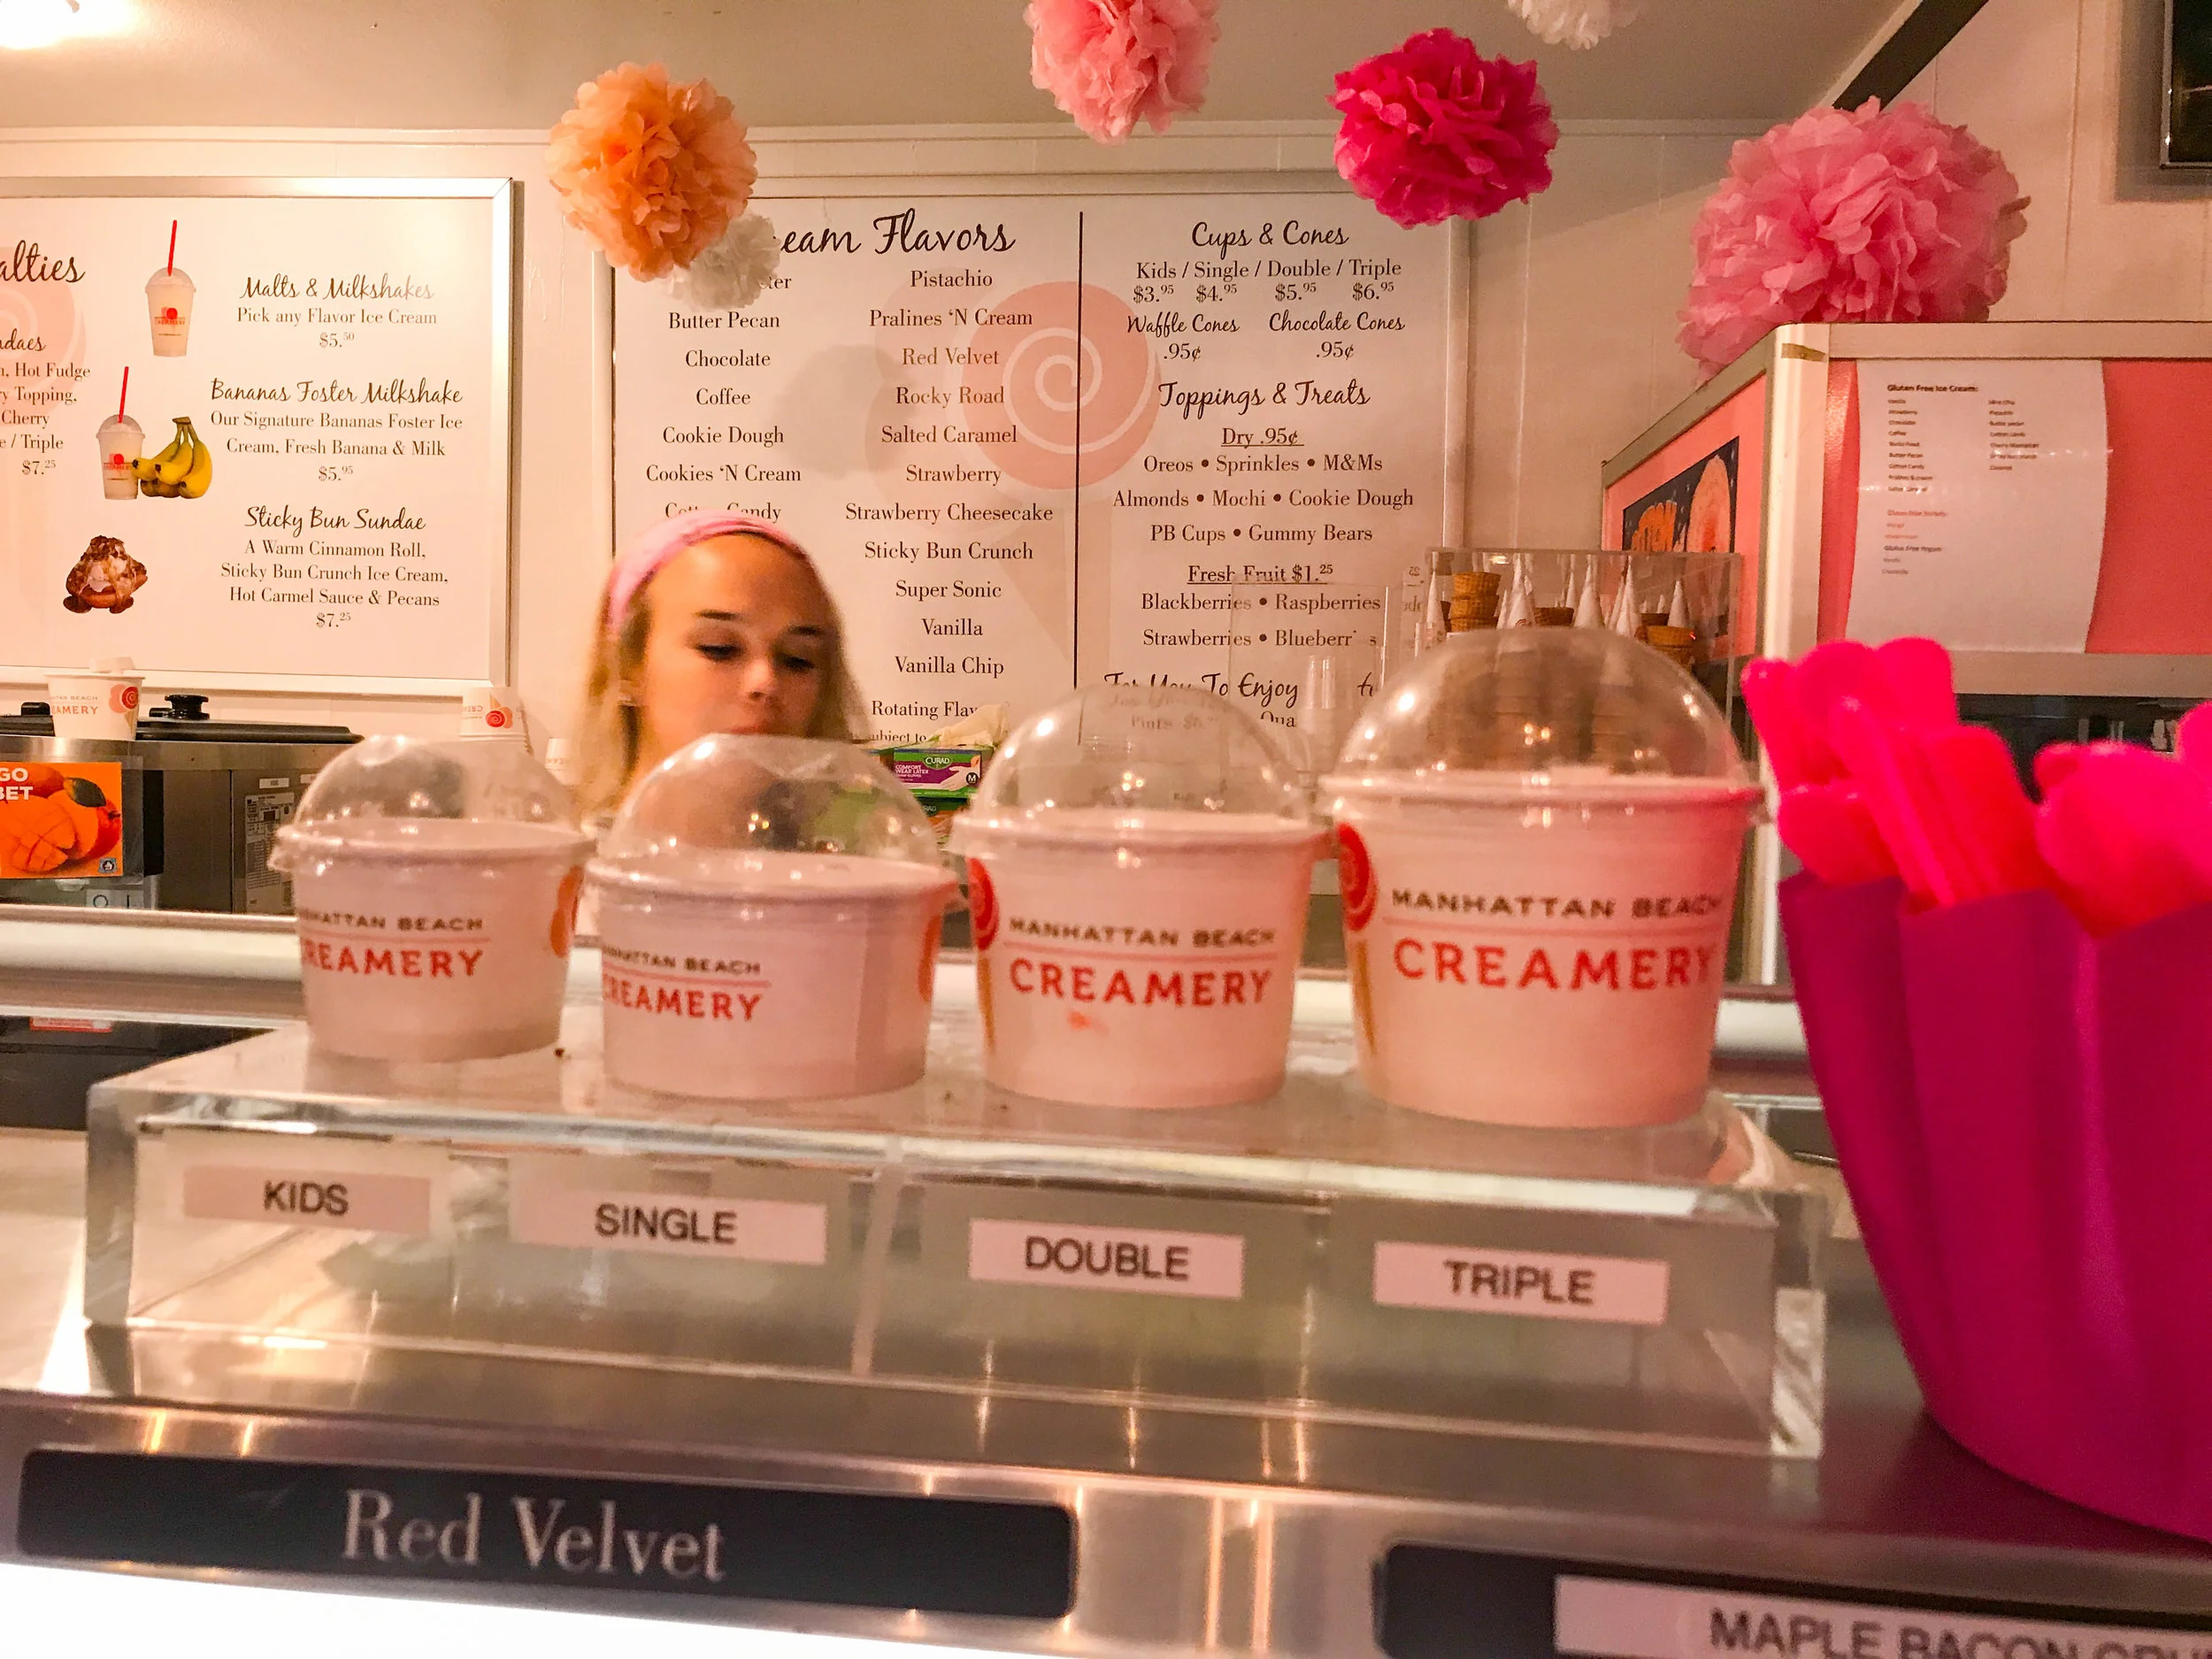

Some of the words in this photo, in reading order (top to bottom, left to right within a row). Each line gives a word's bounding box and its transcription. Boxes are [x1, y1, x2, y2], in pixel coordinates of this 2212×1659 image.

[773, 228, 862, 253] eam
[873, 208, 1016, 254] Flavors
[1192, 222, 1252, 263] Cups
[1259, 223, 1273, 244] &
[1283, 220, 1349, 245] Cones
[910, 269, 992, 287] Pistachio
[1137, 262, 1176, 279] Kids
[1194, 260, 1248, 282] Single
[1268, 259, 1330, 276] Double
[1349, 258, 1401, 280] Triple
[240, 273, 299, 298] Malts
[306, 279, 318, 296] &
[322, 273, 434, 300] Milkshakes
[1133, 285, 1173, 303] $3.95
[1196, 284, 1237, 303] $4.95
[1275, 282, 1316, 302] $5.95
[1353, 282, 1394, 301] $6.95
[238, 307, 269, 322] Pick
[276, 313, 299, 326] any
[309, 308, 355, 323] Flavor
[362, 309, 382, 323] Ice
[388, 309, 436, 324] Cream
[670, 312, 722, 328] Butter
[728, 311, 779, 327] Pecan
[871, 309, 941, 326] Pralines
[975, 308, 1032, 325] Cream
[1128, 311, 1187, 338] Waffle
[1193, 314, 1240, 332] Cones
[1270, 310, 1351, 331] Chocolate
[1357, 311, 1405, 330] Cones
[319, 333, 354, 348] $5.50
[686, 349, 770, 366] Chocolate
[902, 347, 937, 365] Red
[946, 347, 998, 365] Velvet
[16, 363, 39, 377] Hot
[47, 363, 90, 381] Fudge
[14, 386, 76, 405] Topping,
[211, 378, 290, 401] Bananas
[297, 380, 357, 402] Foster
[361, 378, 463, 404] Milkshake
[696, 388, 750, 404] Coffee
[896, 387, 951, 408] Rocky
[960, 386, 1003, 403] Road
[1886, 383, 1915, 392] Gluten
[1916, 383, 1934, 392] Free
[1158, 381, 1265, 420] Toppings
[1272, 382, 1286, 403] &
[1294, 379, 1371, 405] Treats
[2, 410, 47, 429] Cherry
[211, 411, 239, 425] Our
[244, 412, 313, 429] Signature
[321, 413, 382, 427] Bananas
[389, 414, 434, 428] Foster
[441, 414, 462, 428] Ice
[20, 434, 63, 453] Triple
[664, 426, 721, 442] Cookie
[729, 426, 783, 447] Dough
[882, 425, 936, 442] Salted
[944, 425, 1016, 442] Caramel
[1221, 428, 1256, 448] Dry
[227, 439, 279, 453] Cream,
[286, 439, 326, 453] Fresh
[333, 440, 387, 455] Banana
[393, 441, 403, 455] &
[412, 441, 445, 456] Milk
[22, 460, 56, 474] $7.25
[319, 466, 353, 481] $5.95
[647, 465, 713, 480] Cookies
[745, 465, 800, 480] Cream
[907, 465, 1001, 486] Strawberry
[1144, 456, 1193, 472] Oreos
[1217, 454, 1299, 476] Sprinkles
[1324, 454, 1382, 471] M&Ms
[1114, 489, 1188, 506] Almonds
[1213, 489, 1265, 506] Mochi
[1289, 489, 1349, 506] Cookie
[1357, 488, 1413, 510] Dough
[245, 505, 302, 537] Sticky
[311, 506, 349, 528] Bun
[354, 507, 426, 529] Sundae
[847, 503, 941, 525] Strawberry
[948, 503, 1053, 520] Cheesecake
[1151, 525, 1175, 541] PB
[1182, 525, 1225, 546] Cups
[1249, 525, 1316, 545] Gummy
[1324, 525, 1372, 541] Bears
[244, 540, 256, 555] A
[263, 540, 303, 555] Warm
[310, 541, 384, 557] Cinnamon
[391, 542, 425, 557] Roll,
[865, 541, 919, 563] Sticky
[927, 542, 961, 558] Bun
[969, 541, 1033, 559] Crunch
[221, 563, 266, 581] Sticky
[274, 564, 301, 579] Bun
[308, 565, 361, 580] Crunch
[368, 566, 389, 580] Ice
[396, 566, 448, 581] Cream,
[1188, 565, 1235, 581] Fresh
[1244, 565, 1286, 581] Fruit
[1289, 564, 1333, 585] $1.25
[231, 587, 254, 601] Hot
[262, 588, 312, 603] Carmel
[319, 589, 363, 603] Sauce
[369, 590, 379, 604] &
[388, 590, 439, 605] Pecans
[896, 580, 948, 602] Super
[953, 580, 1001, 597] Sonic
[1142, 593, 1250, 610] Blackberries
[1276, 593, 1380, 614] Raspberries
[317, 612, 350, 627] $7.25
[922, 618, 983, 635] Vanilla
[1144, 629, 1251, 645] Strawberries
[1276, 629, 1376, 646] Blueberrs
[895, 657, 956, 672] Vanilla
[962, 657, 1003, 679] Chip
[1202, 672, 1228, 695] To
[1238, 672, 1297, 709] Enjoy
[872, 701, 938, 720] Rotating
[1392, 888, 1616, 918] MANHATTAN
[397, 916, 484, 930] BEACH
[1009, 918, 1179, 947] MANHATTAN
[1193, 926, 1276, 947] BEACH
[684, 956, 761, 974] BEACH
[1009, 957, 1272, 1007] CREAMERY
[264, 1181, 349, 1217] KIDS
[595, 1203, 737, 1245] SINGLE
[1025, 1236, 1189, 1281] DOUBLE
[1443, 1260, 1595, 1306] TRIPLE
[342, 1486, 482, 1568] Red
[510, 1492, 727, 1584] Velvet
[1708, 1606, 1883, 1659] MAPLE
